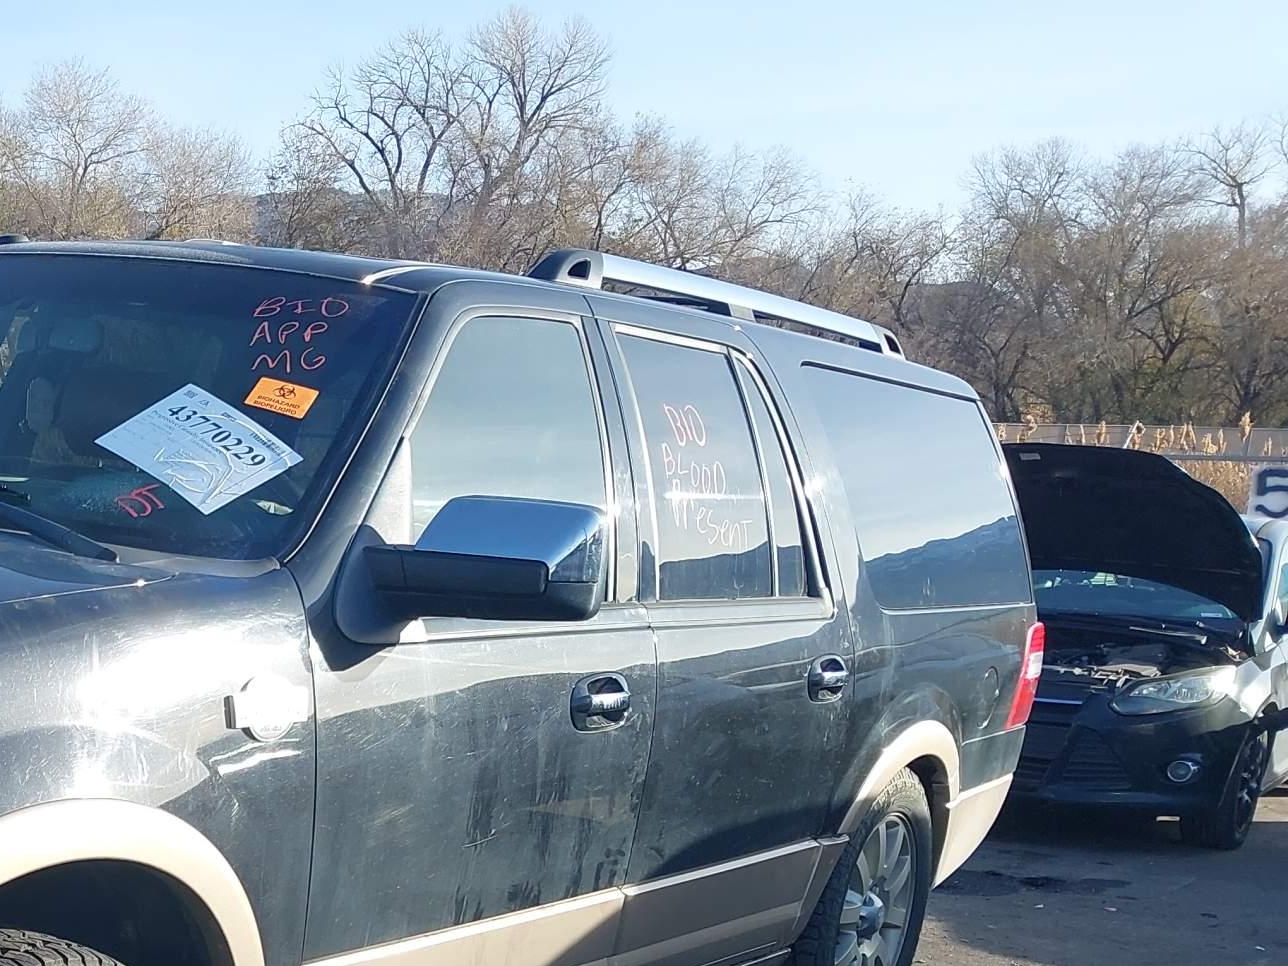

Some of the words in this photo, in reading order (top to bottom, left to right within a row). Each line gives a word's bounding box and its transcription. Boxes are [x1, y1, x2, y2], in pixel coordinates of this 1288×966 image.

[253, 296, 349, 318] BIO
[249, 321, 329, 347] APP
[251, 347, 326, 373] MG
[257, 395, 300, 410] BIOHAZARD
[167, 404, 266, 468] 43770229
[661, 442, 726, 496] BLOOD
